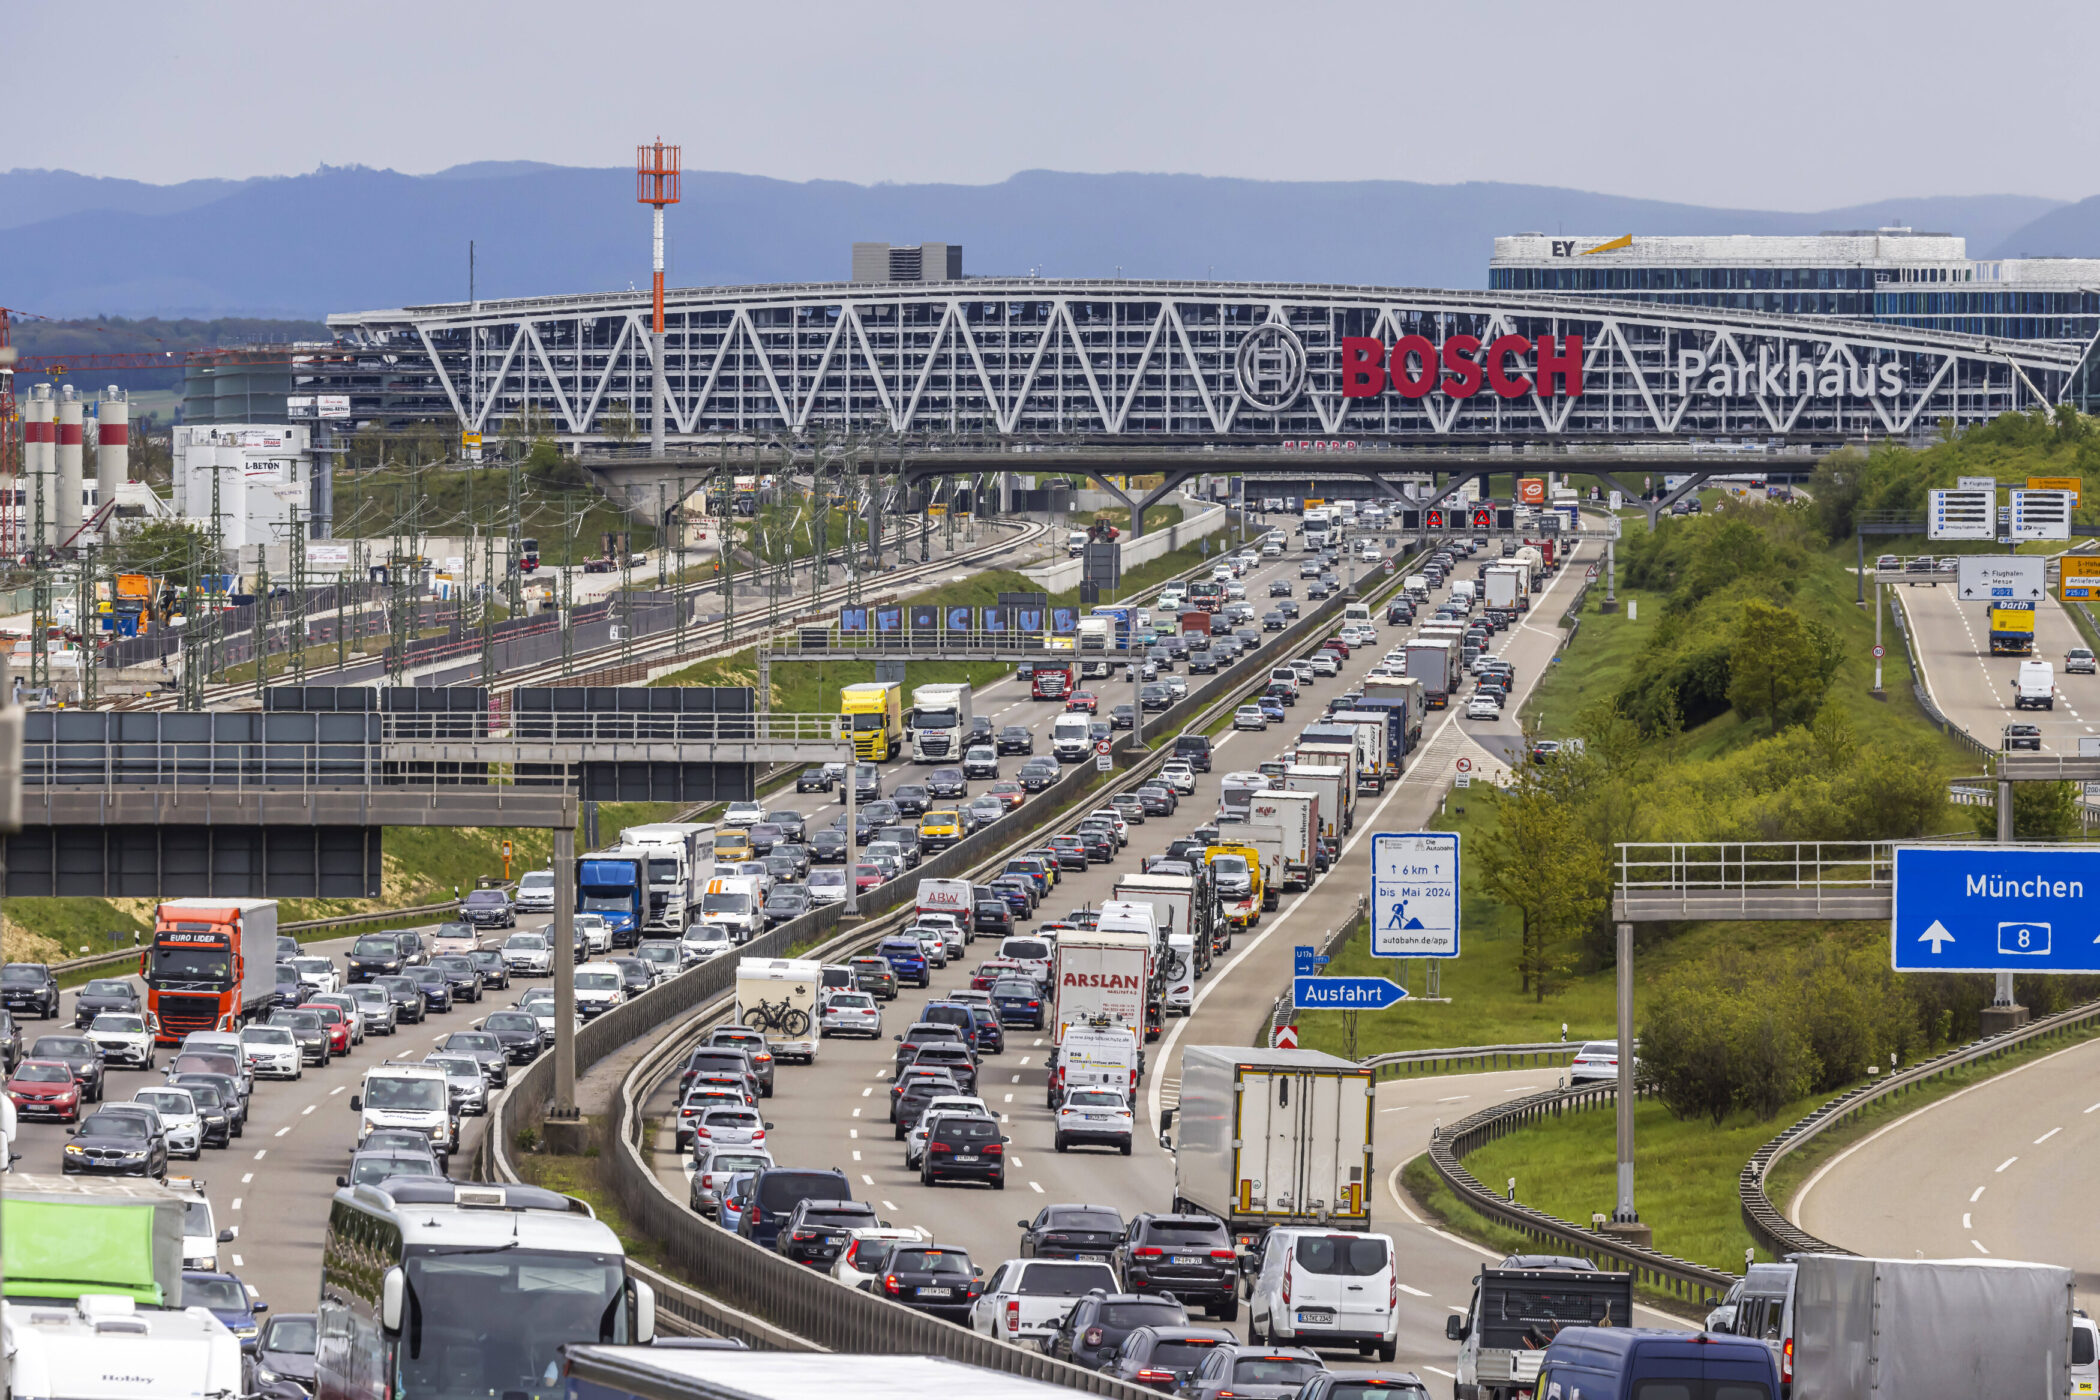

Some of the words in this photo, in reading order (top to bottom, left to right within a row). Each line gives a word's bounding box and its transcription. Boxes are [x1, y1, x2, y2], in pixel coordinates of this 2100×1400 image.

[1552, 240, 1576, 257] EY
[1342, 334, 1583, 399] BOSCH
[1678, 344, 1904, 397] Parkhaus
[1999, 601, 2029, 610] barth
[1402, 865, 1409, 875] 6
[1411, 865, 1428, 875] km
[1379, 887, 1396, 897] bis
[1401, 887, 1421, 897] Mai
[1425, 887, 1451, 897] 2024
[1966, 874, 2084, 898] München
[928, 892, 959, 903] ABW
[170, 934, 192, 942] EURO
[193, 935, 215, 943] LIDER
[1382, 937, 1449, 946] autobahn.de/app
[2017, 929, 2030, 948] 8
[1063, 972, 1139, 989] ARSLAN
[1304, 984, 1382, 1001] Ausfahrt
